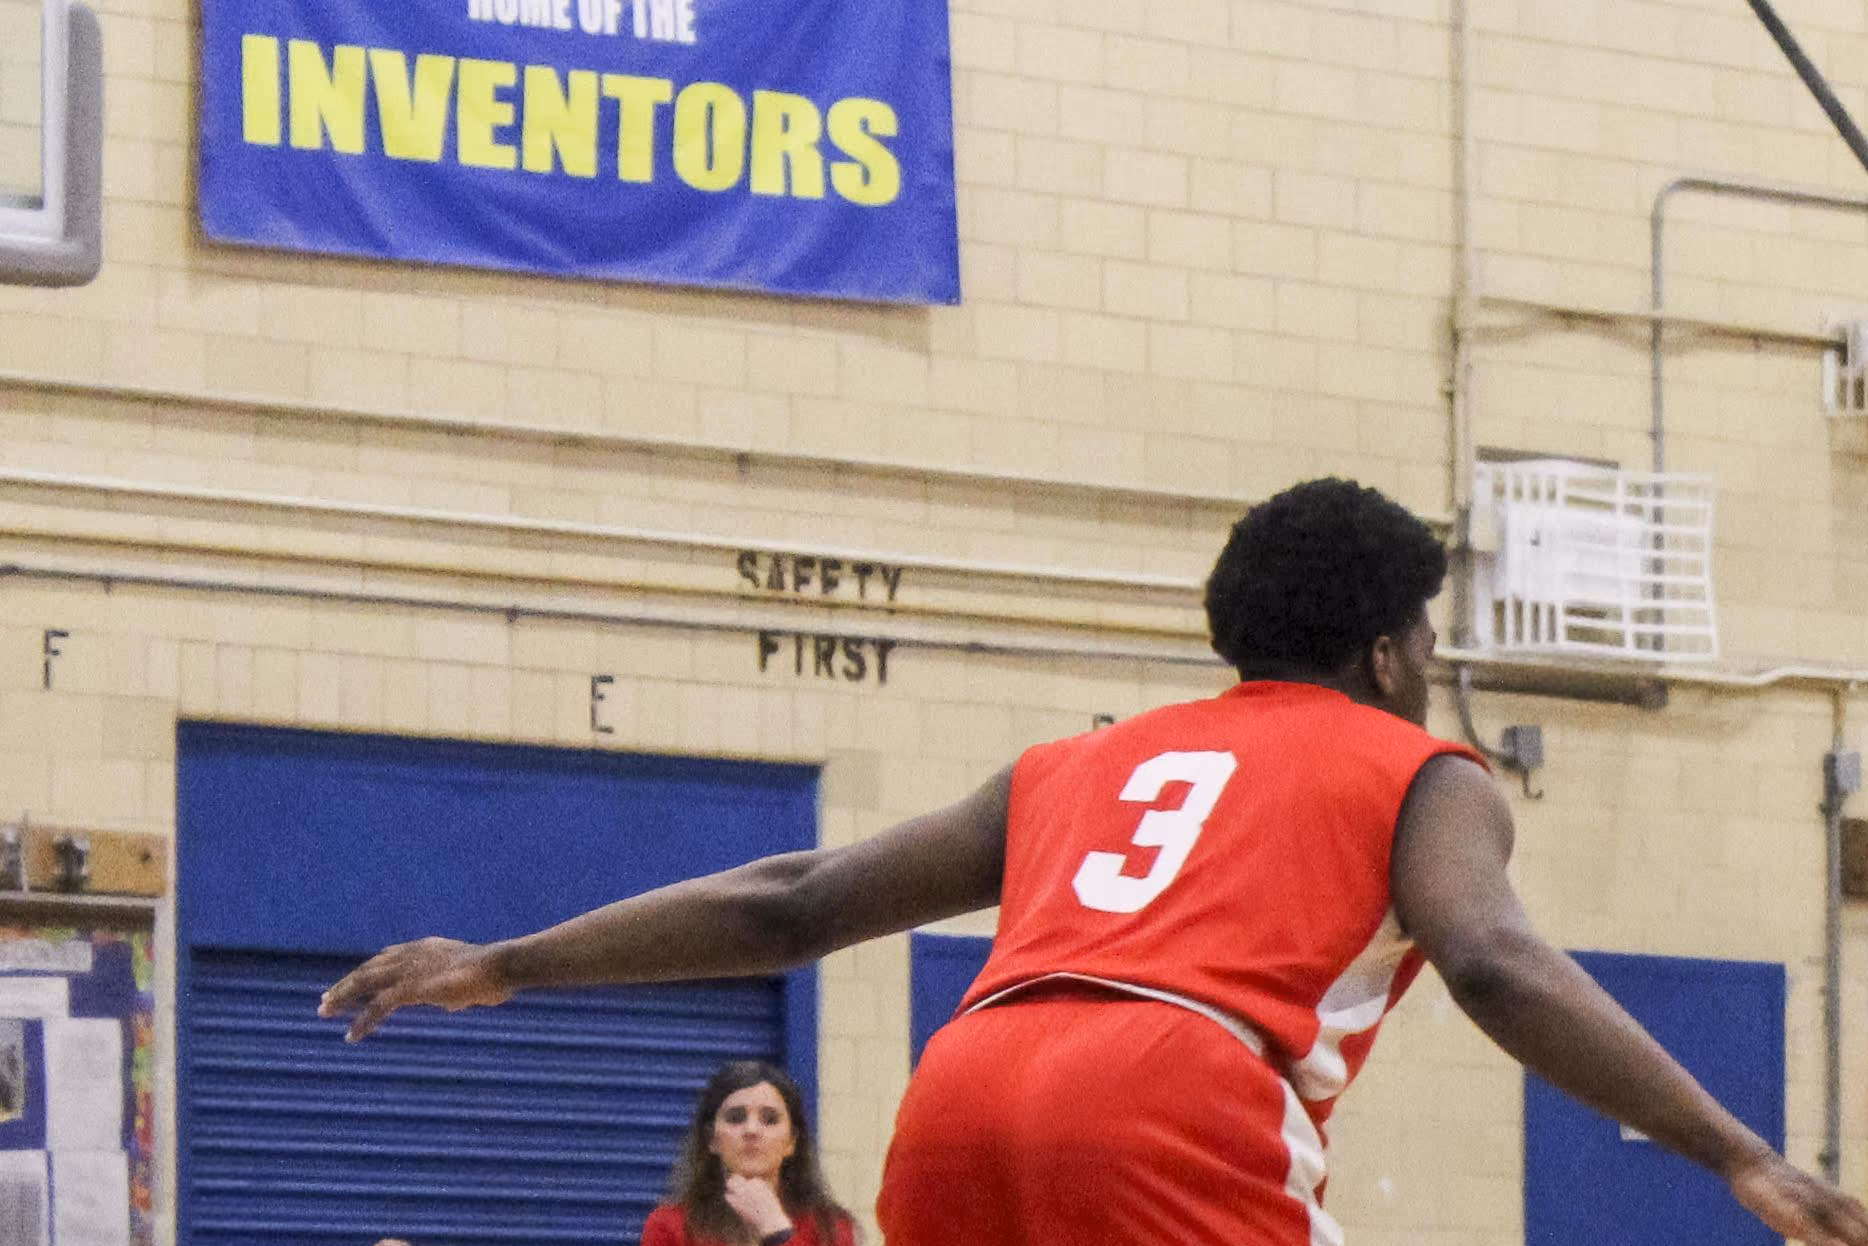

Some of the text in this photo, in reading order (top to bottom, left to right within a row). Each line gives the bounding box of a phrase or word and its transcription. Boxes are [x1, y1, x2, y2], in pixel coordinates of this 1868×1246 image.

[242, 33, 901, 207] INVENTORS
[737, 550, 902, 601] SAFETY
[43, 629, 69, 690] F
[758, 630, 898, 686] FIRST
[591, 674, 614, 734] E
[1072, 750, 1240, 914] 3
